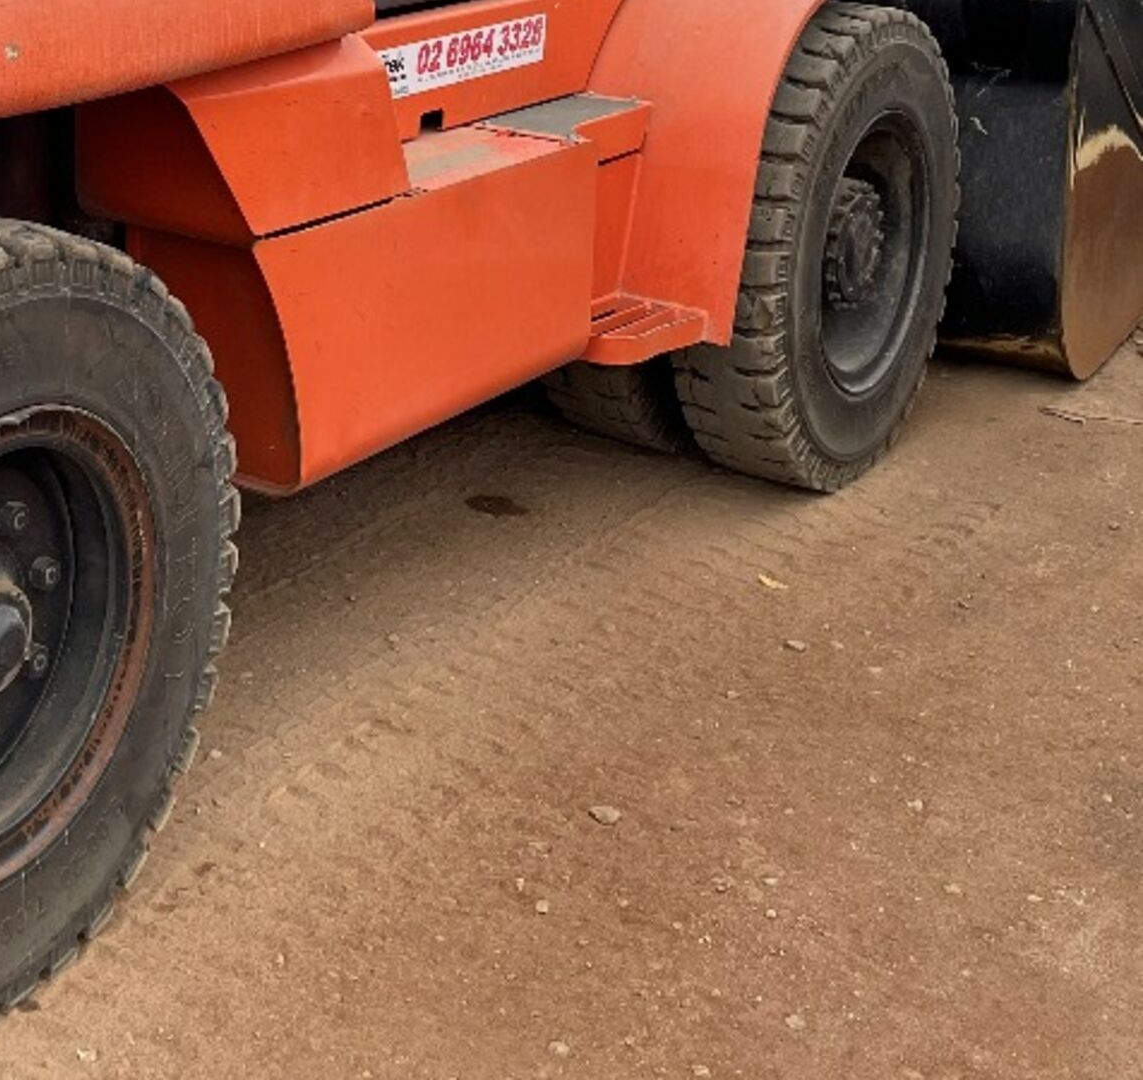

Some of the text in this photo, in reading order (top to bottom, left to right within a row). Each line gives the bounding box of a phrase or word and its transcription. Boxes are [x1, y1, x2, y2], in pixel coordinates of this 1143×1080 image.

[417, 40, 443, 75] 02
[446, 28, 496, 69] 6964
[497, 16, 544, 56] 3328
